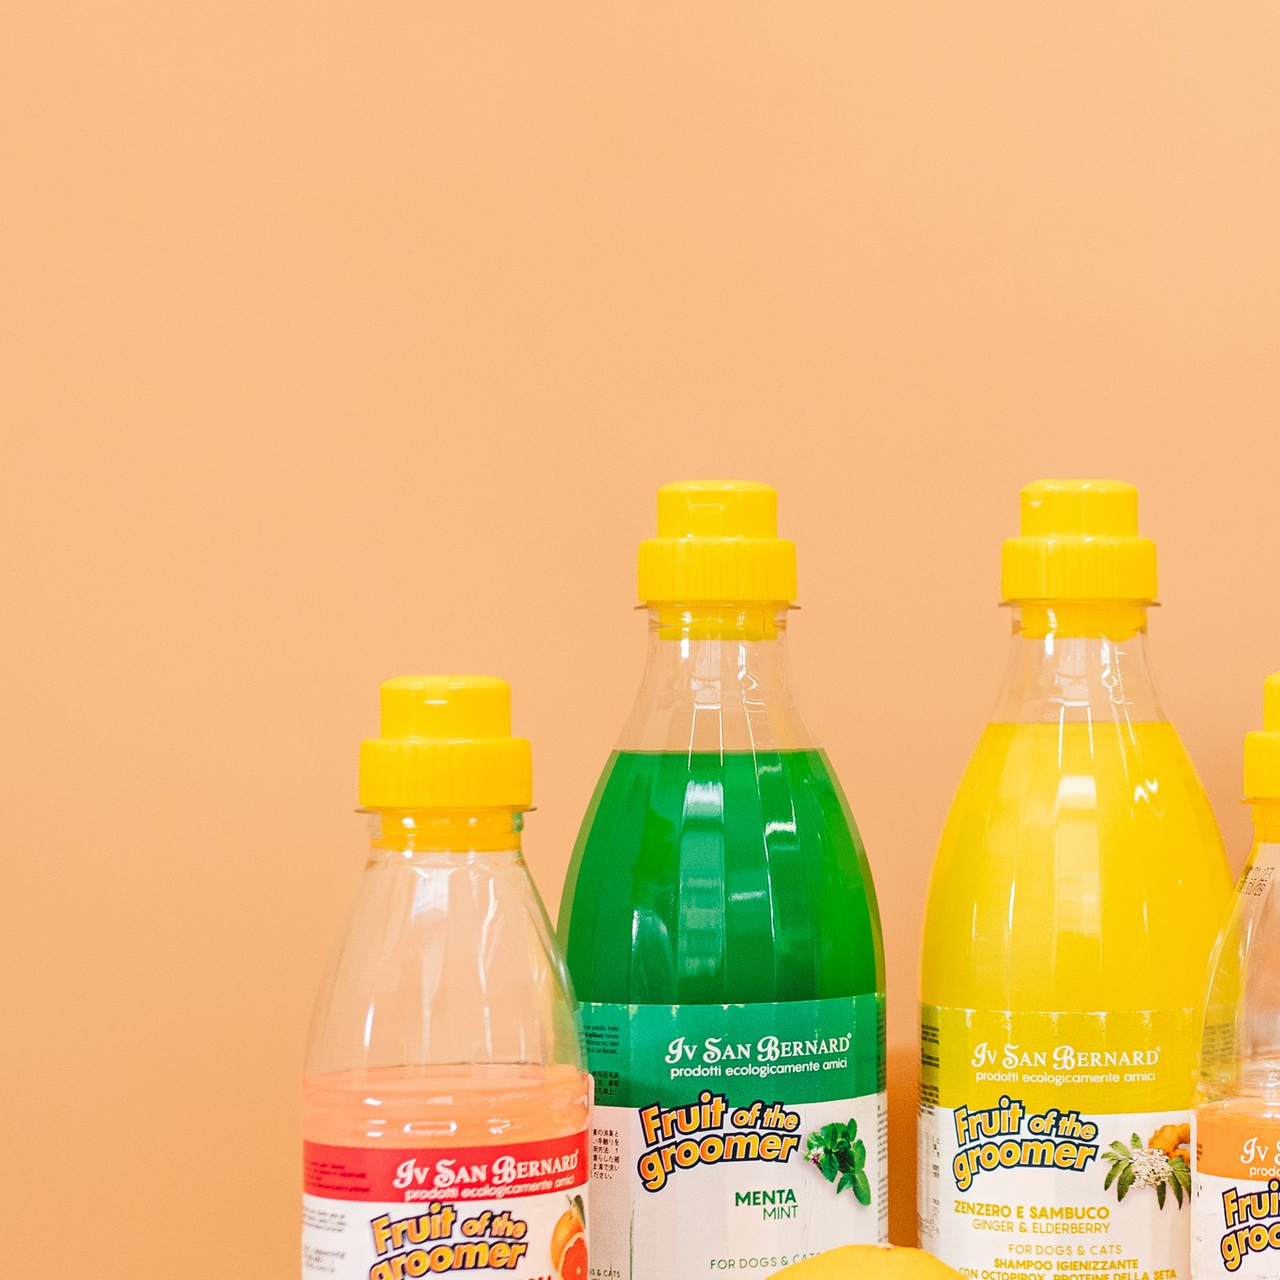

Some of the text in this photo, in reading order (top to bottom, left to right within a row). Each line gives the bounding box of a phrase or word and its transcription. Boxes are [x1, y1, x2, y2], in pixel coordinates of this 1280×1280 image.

[670, 1058, 847, 1079] prodotti ecologicamente amici
[976, 1071, 1156, 1086] prodotti ecologicamente amici
[639, 1089, 728, 1146] Fruit
[731, 1100, 763, 1128] of
[760, 1101, 800, 1132] the
[953, 1095, 1099, 1147] Fruit of the
[637, 1132, 801, 1192] groomer
[952, 1139, 1099, 1192] groomer
[405, 1174, 574, 1201] prodotti ecologicamente amici
[735, 1189, 797, 1206] MENTA
[763, 1205, 798, 1220] MINT
[954, 1200, 1110, 1219] ZENZERO E SAMBUCO
[371, 1201, 457, 1257] Fruit
[461, 1210, 492, 1238] of
[490, 1211, 527, 1240] the
[972, 1219, 1110, 1234] GINGER & ELDERBERRY
[1009, 1244, 1121, 1255] FOR DOGS & CATS
[711, 1252, 821, 1269] FOR DOGS & CA
[994, 1258, 1138, 1271] SHAMPOO IGIENIZZANTE
[603, 1269, 620, 1278] CATS
[1154, 1270, 1177, 1280] SETA
